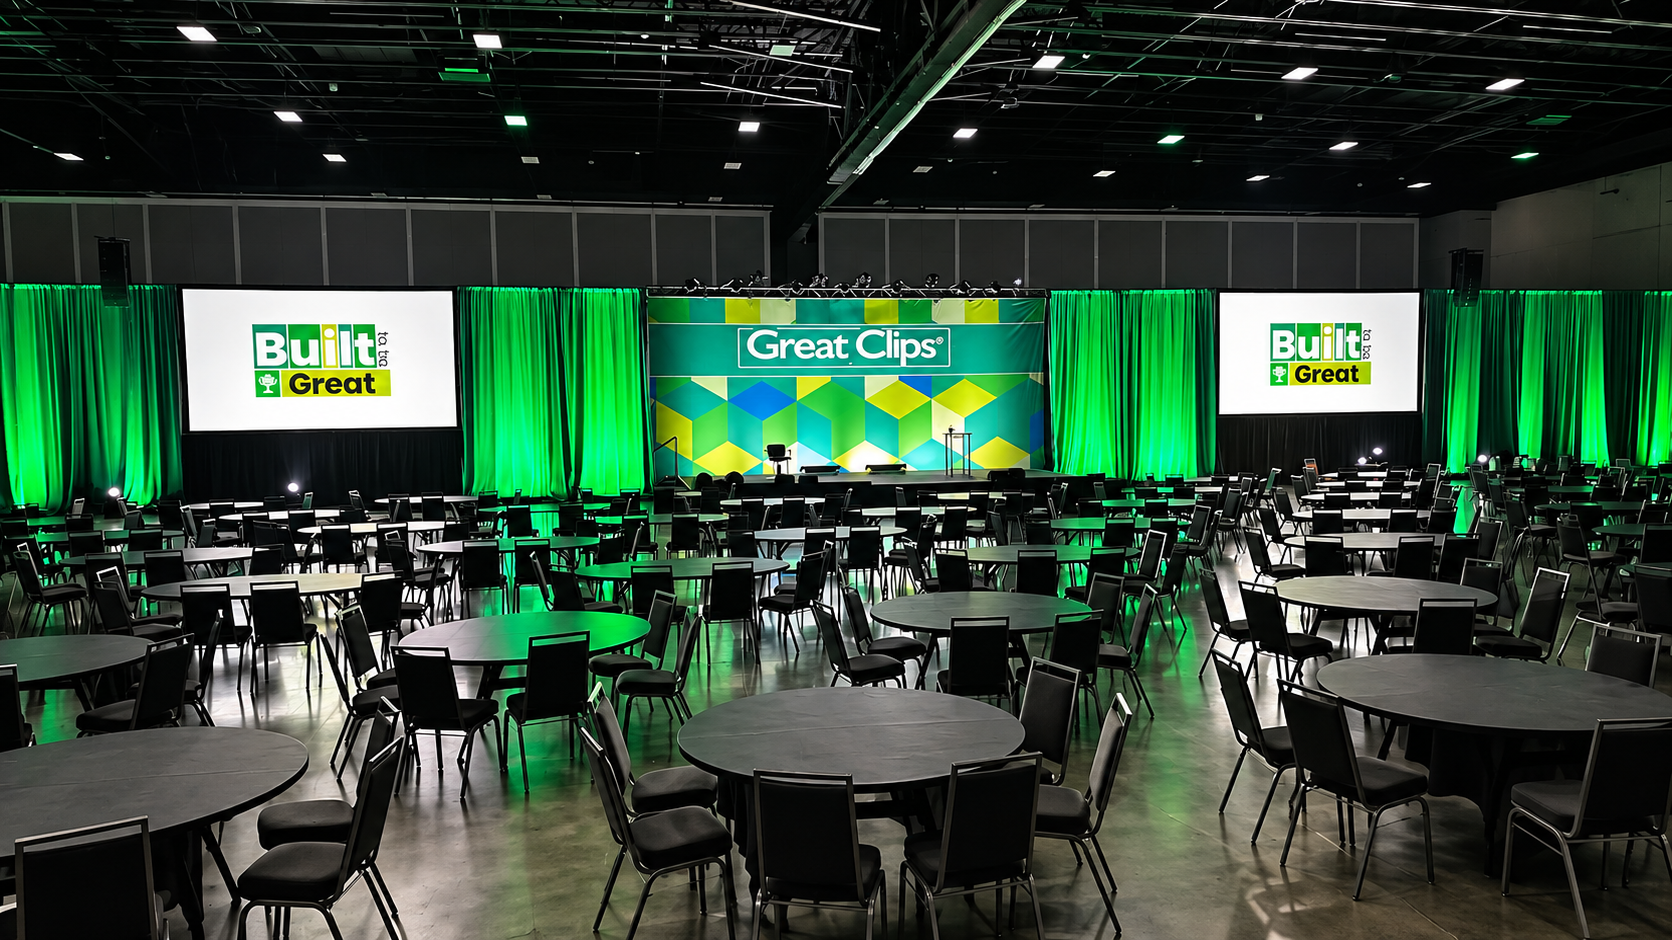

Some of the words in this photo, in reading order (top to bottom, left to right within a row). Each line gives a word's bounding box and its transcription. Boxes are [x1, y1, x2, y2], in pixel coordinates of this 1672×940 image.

[255, 328, 375, 366] Built
[746, 329, 850, 360] Great
[1272, 326, 1360, 360] Built
[288, 372, 376, 395] Great
[1294, 364, 1360, 384] Great
